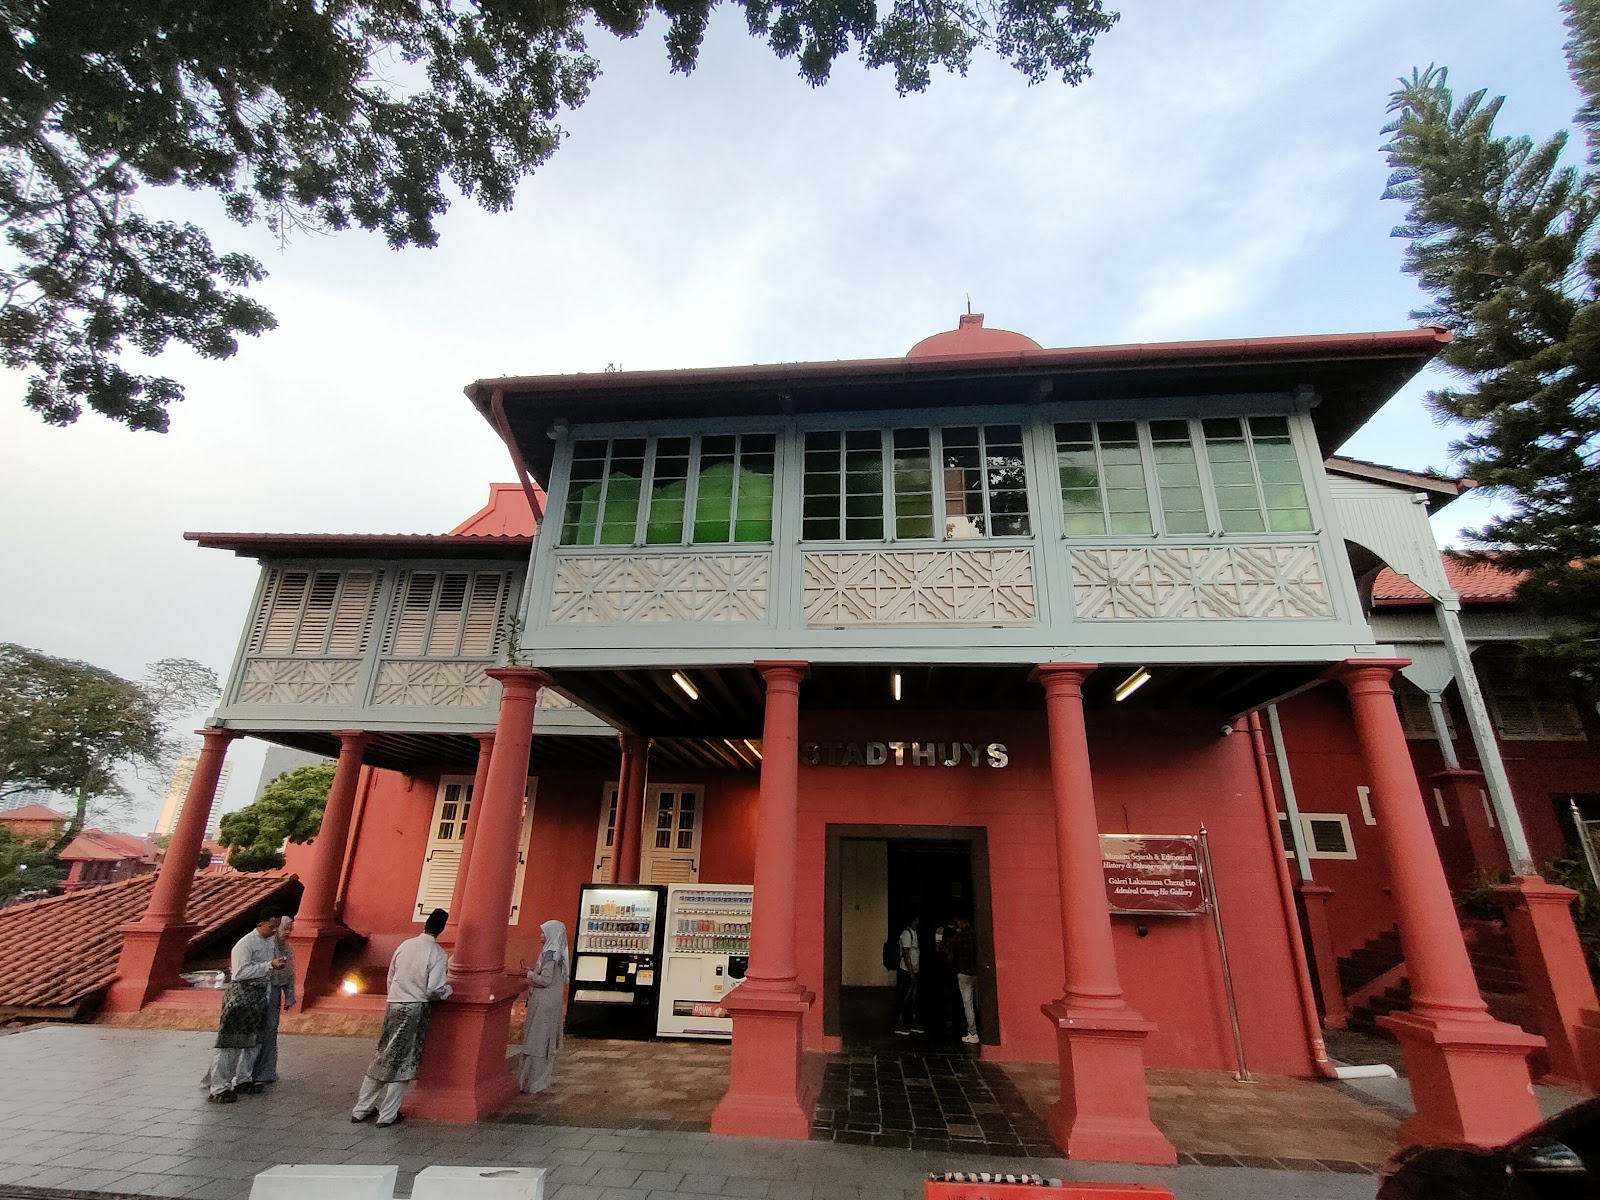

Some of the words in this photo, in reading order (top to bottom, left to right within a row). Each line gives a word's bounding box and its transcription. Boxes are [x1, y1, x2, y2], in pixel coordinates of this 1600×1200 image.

[800, 741, 1009, 768] STADTHUYS
[1131, 852, 1153, 861] Sejarah
[1103, 862, 1125, 870] History
[1132, 862, 1171, 871] Ethnography
[1129, 878, 1163, 886] Laksamana
[1164, 879, 1185, 887] Cheng
[1114, 887, 1139, 895] Admiral
[1140, 888, 1159, 896] Cheng
[1160, 888, 1169, 896] Ho
[1169, 888, 1193, 897] Gallery
